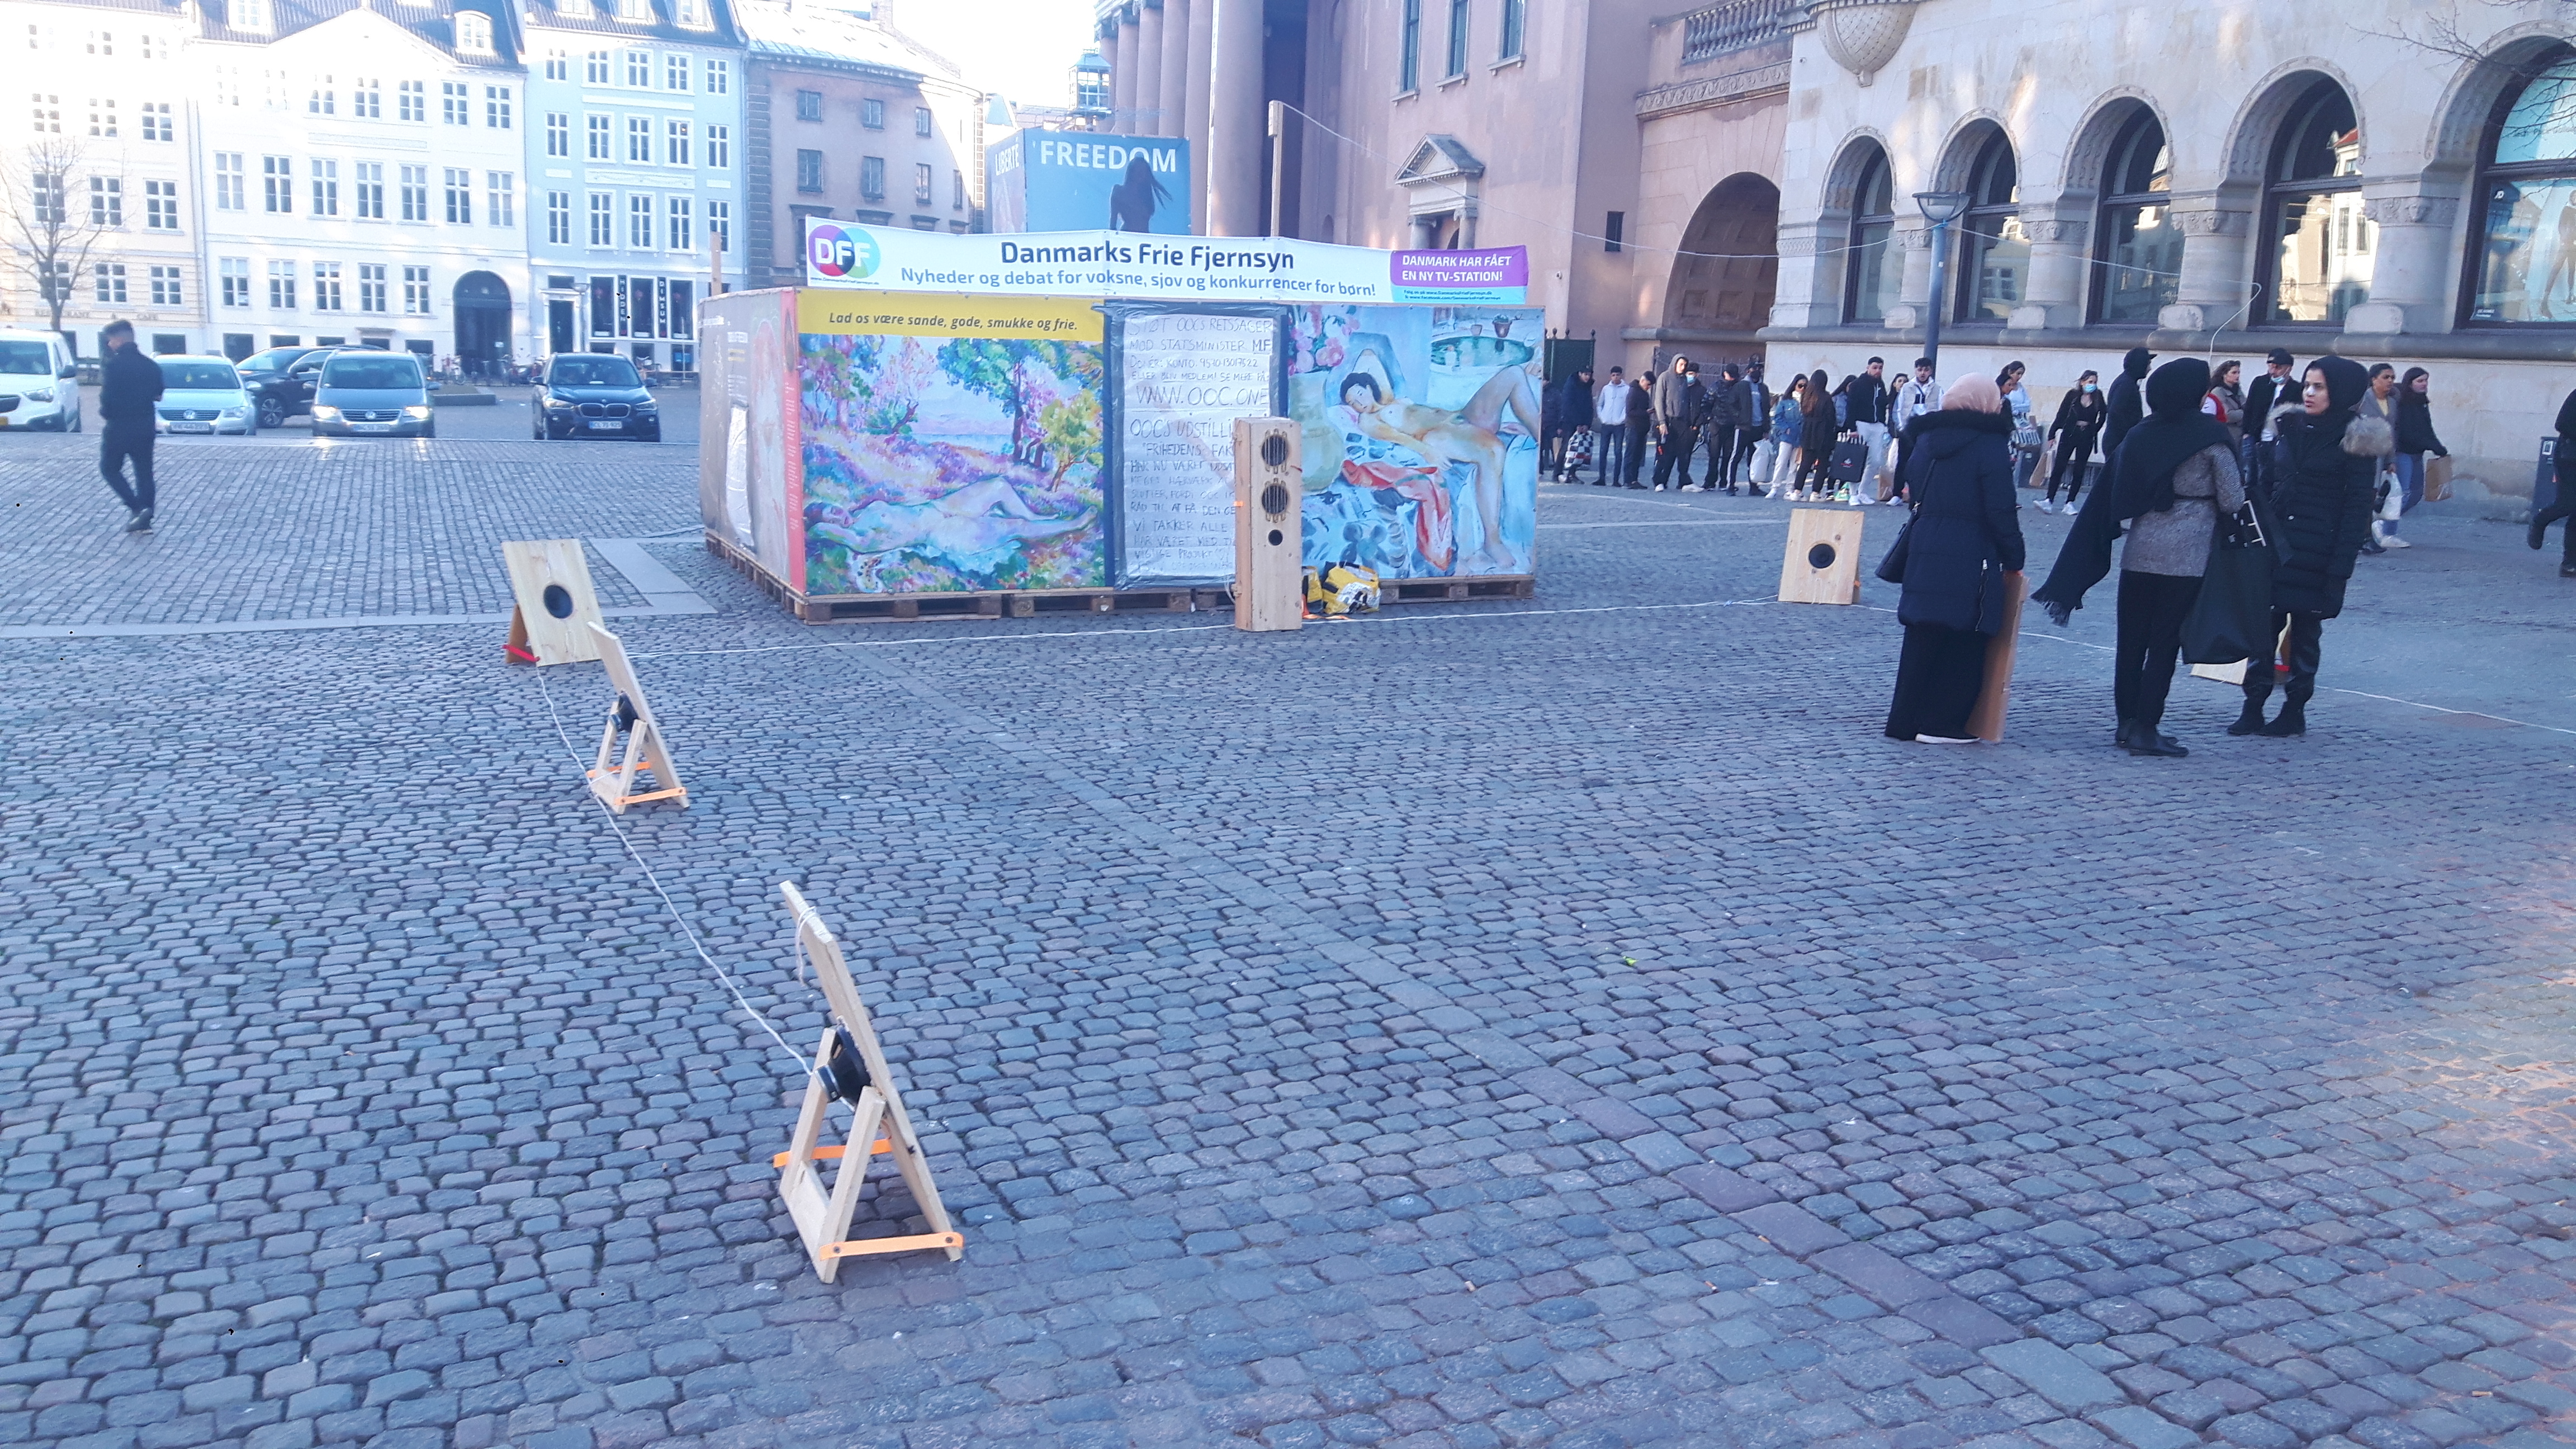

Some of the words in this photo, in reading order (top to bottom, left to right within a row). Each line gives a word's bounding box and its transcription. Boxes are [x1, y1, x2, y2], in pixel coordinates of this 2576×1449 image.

[995, 136, 1020, 176] LIBERTÉ
[1041, 140, 1176, 173] FREEDOM
[815, 238, 871, 267] DFF
[1001, 240, 1131, 263] Danmarks
[1139, 243, 1183, 266] Frie
[1190, 245, 1294, 273] Fjernsyn
[1402, 255, 1457, 267] DANMARK
[1459, 256, 1482, 267] HAR
[1484, 253, 1512, 266] FÅET
[901, 267, 975, 285] Nyheder
[979, 273, 1001, 287] og
[1005, 271, 1054, 285] debat
[1058, 270, 1083, 284] for
[1086, 269, 1147, 287] voksne,
[1151, 273, 1182, 290] sjov
[1187, 277, 1206, 290] og
[1210, 274, 1313, 291] konkurrencer
[1314, 279, 1335, 293] for
[1338, 281, 1376, 296] børn!
[1402, 270, 1417, 281] EN
[1419, 271, 1434, 281] NY
[1435, 271, 1503, 282] TV-STATION!
[830, 312, 852, 324] Lad
[855, 315, 869, 324] os
[873, 315, 904, 325] være
[907, 316, 947, 328] sande,
[951, 316, 983, 330] gode,
[987, 318, 1034, 329] smukke
[1037, 320, 1050, 331] og
[1053, 319, 1077, 332] frie.
[1128, 318, 1170, 335] STØT
[1129, 339, 1154, 351] MOD
[1161, 339, 1244, 352] STATSMINISTER
